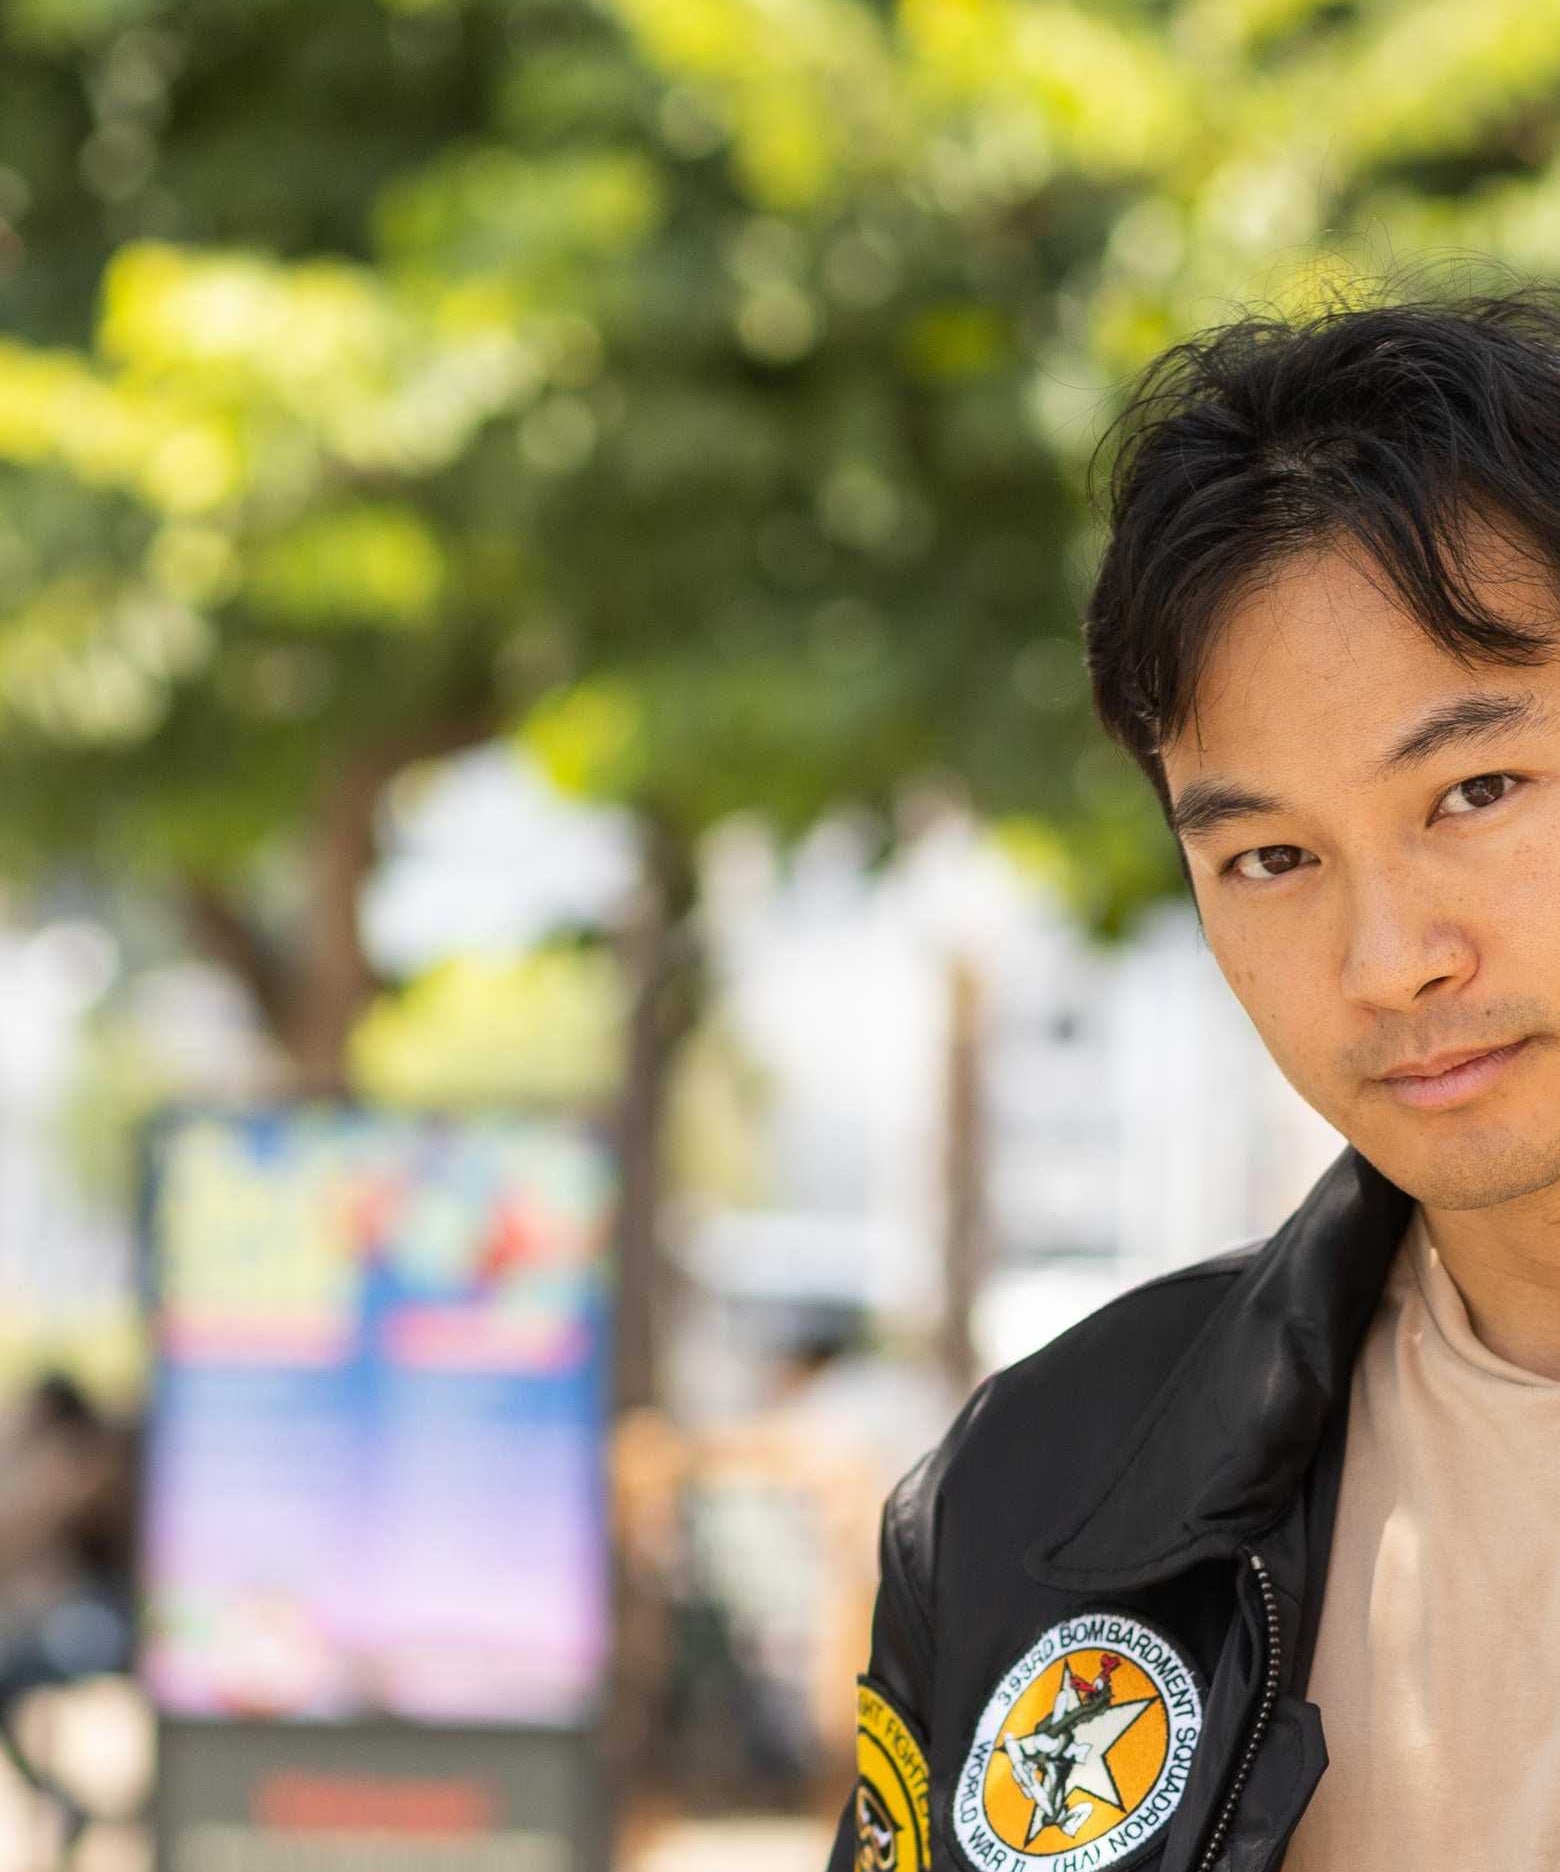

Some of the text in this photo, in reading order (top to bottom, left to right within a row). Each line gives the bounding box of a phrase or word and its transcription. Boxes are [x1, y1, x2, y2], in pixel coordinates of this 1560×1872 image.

[999, 1638, 1055, 1706] 393RD
[1058, 1620, 1196, 1719] BOMBARDMENT
[961, 1740, 992, 1824] WORLD
[1108, 1726, 1197, 1853] SQUADRON
